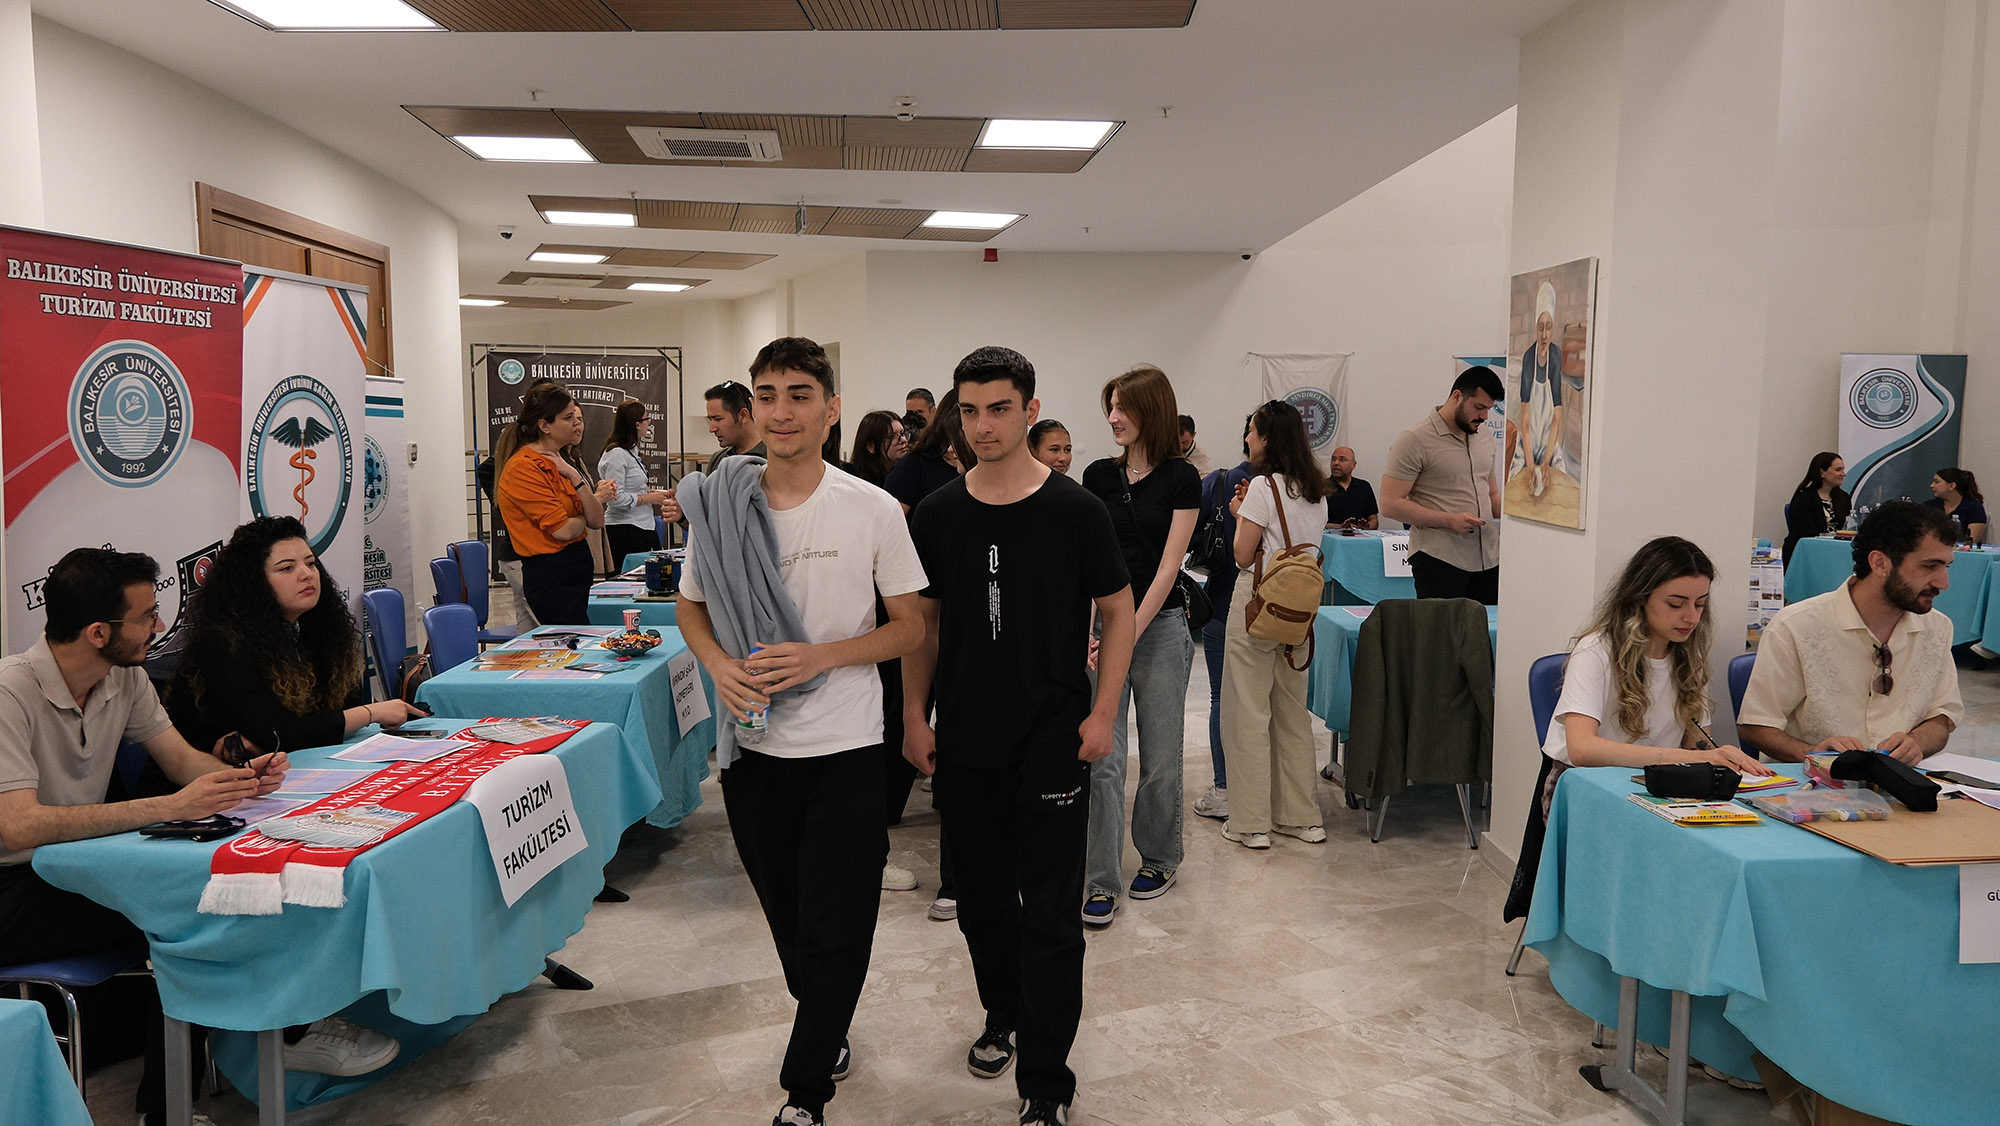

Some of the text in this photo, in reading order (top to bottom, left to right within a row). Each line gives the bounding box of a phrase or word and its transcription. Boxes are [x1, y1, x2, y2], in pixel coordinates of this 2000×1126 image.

[7, 258, 238, 305] BALIKESİR ÜNİVERSİTESİ
[39, 292, 213, 328] TURİZM FAKÜLTESİ
[531, 362, 581, 379] BALIKESİR
[585, 362, 649, 380] ÜNİVERSİTESİ
[83, 356, 181, 434] BALIKESİR ÜNİVERSİTESİ
[121, 462, 147, 474] 1992
[248, 434, 260, 493] BALIKESİR
[364, 549, 385, 564] KESİR
[802, 550, 839, 560] NATURE
[501, 780, 553, 828] TURİZM
[503, 809, 571, 879] FAKÜLTESİ
